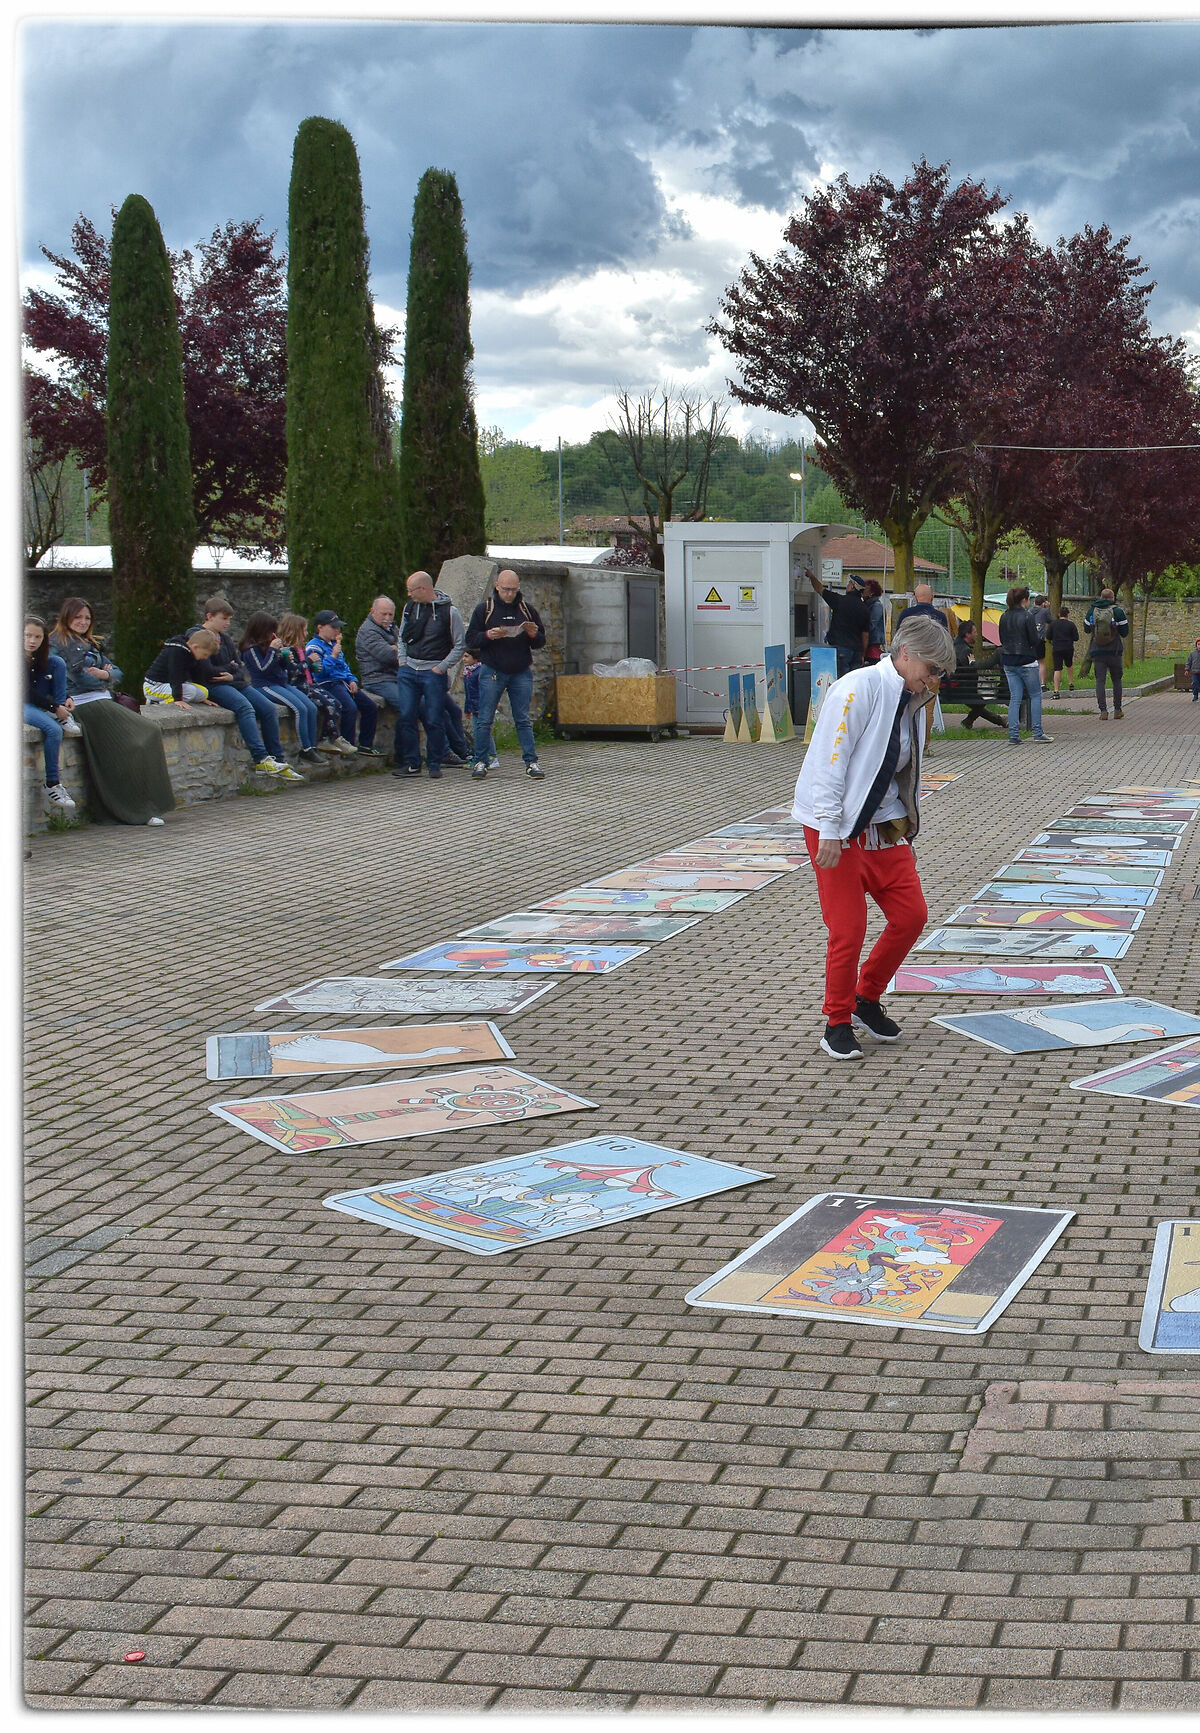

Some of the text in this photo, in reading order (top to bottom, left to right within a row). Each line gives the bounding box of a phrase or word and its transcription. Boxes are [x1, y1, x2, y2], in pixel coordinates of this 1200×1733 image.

[829, 692, 856, 765] STAFF
[593, 1140, 637, 1152] 16
[825, 1198, 878, 1210] 17
